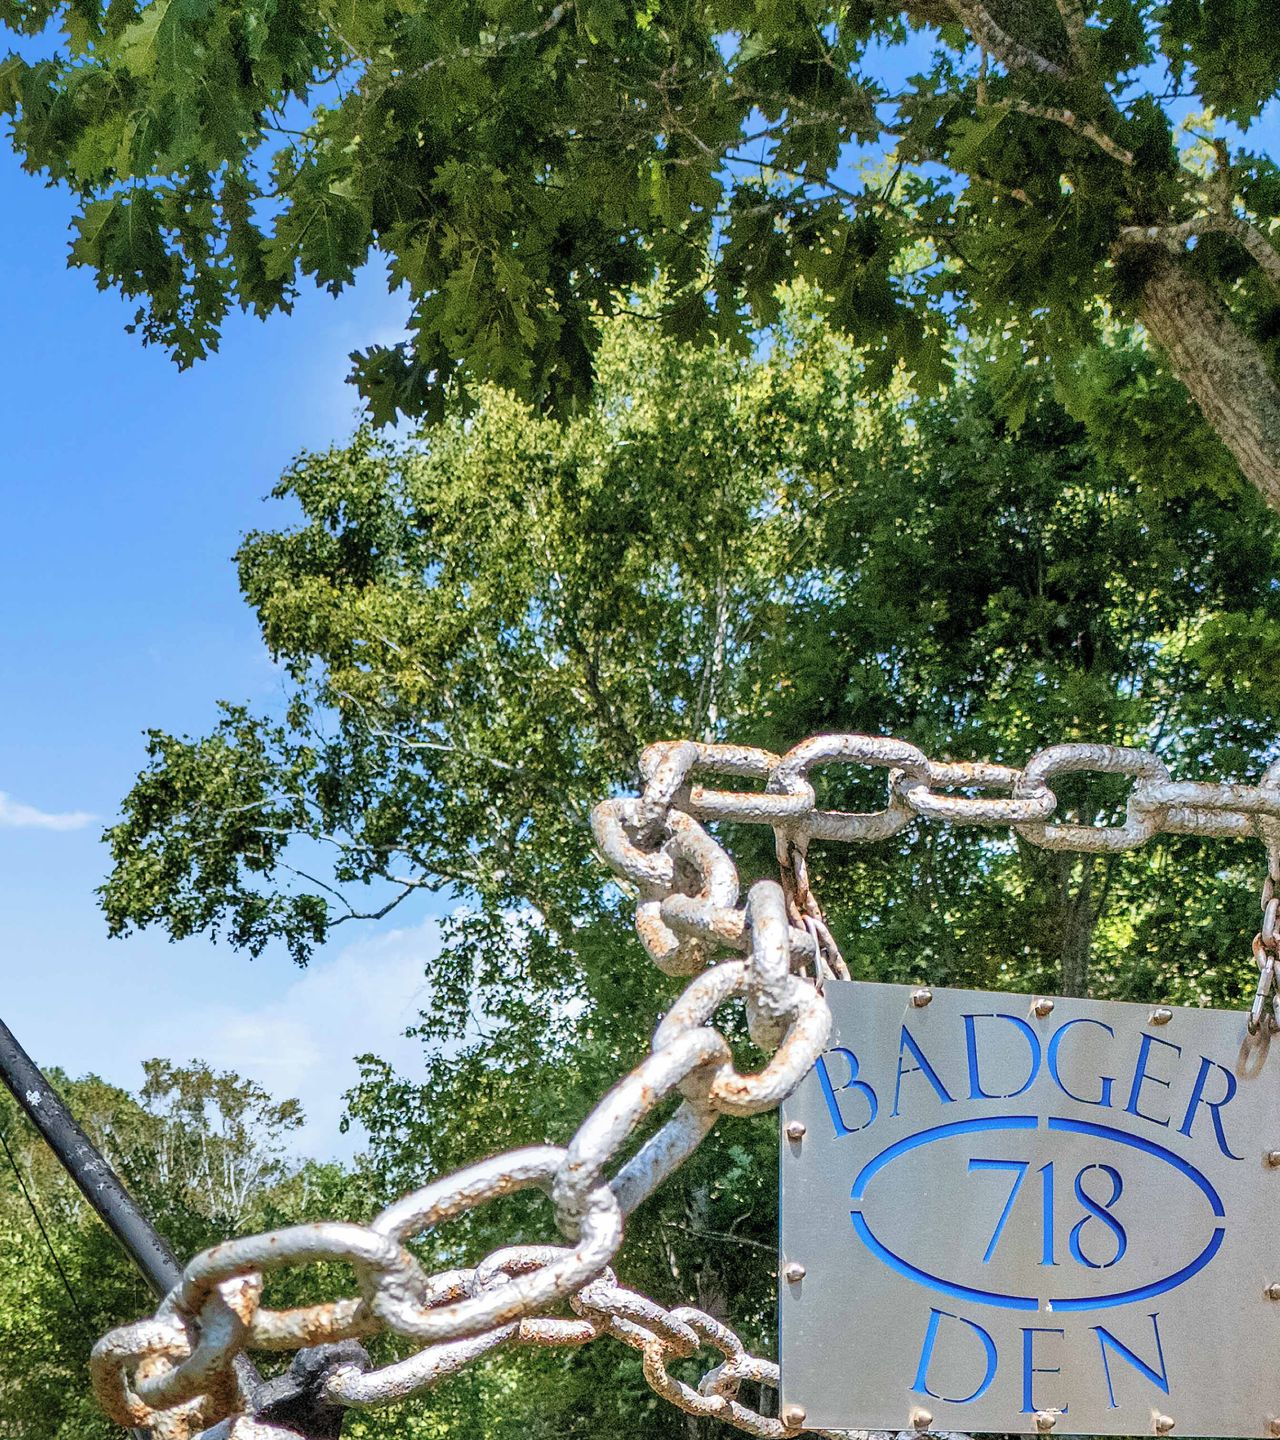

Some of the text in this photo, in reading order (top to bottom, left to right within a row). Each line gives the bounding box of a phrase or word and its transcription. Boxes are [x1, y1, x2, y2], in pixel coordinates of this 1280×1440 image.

[815, 1013, 1245, 1161] BADGER
[967, 1158, 1128, 1269] 718
[908, 1307, 1170, 1415] DEN
